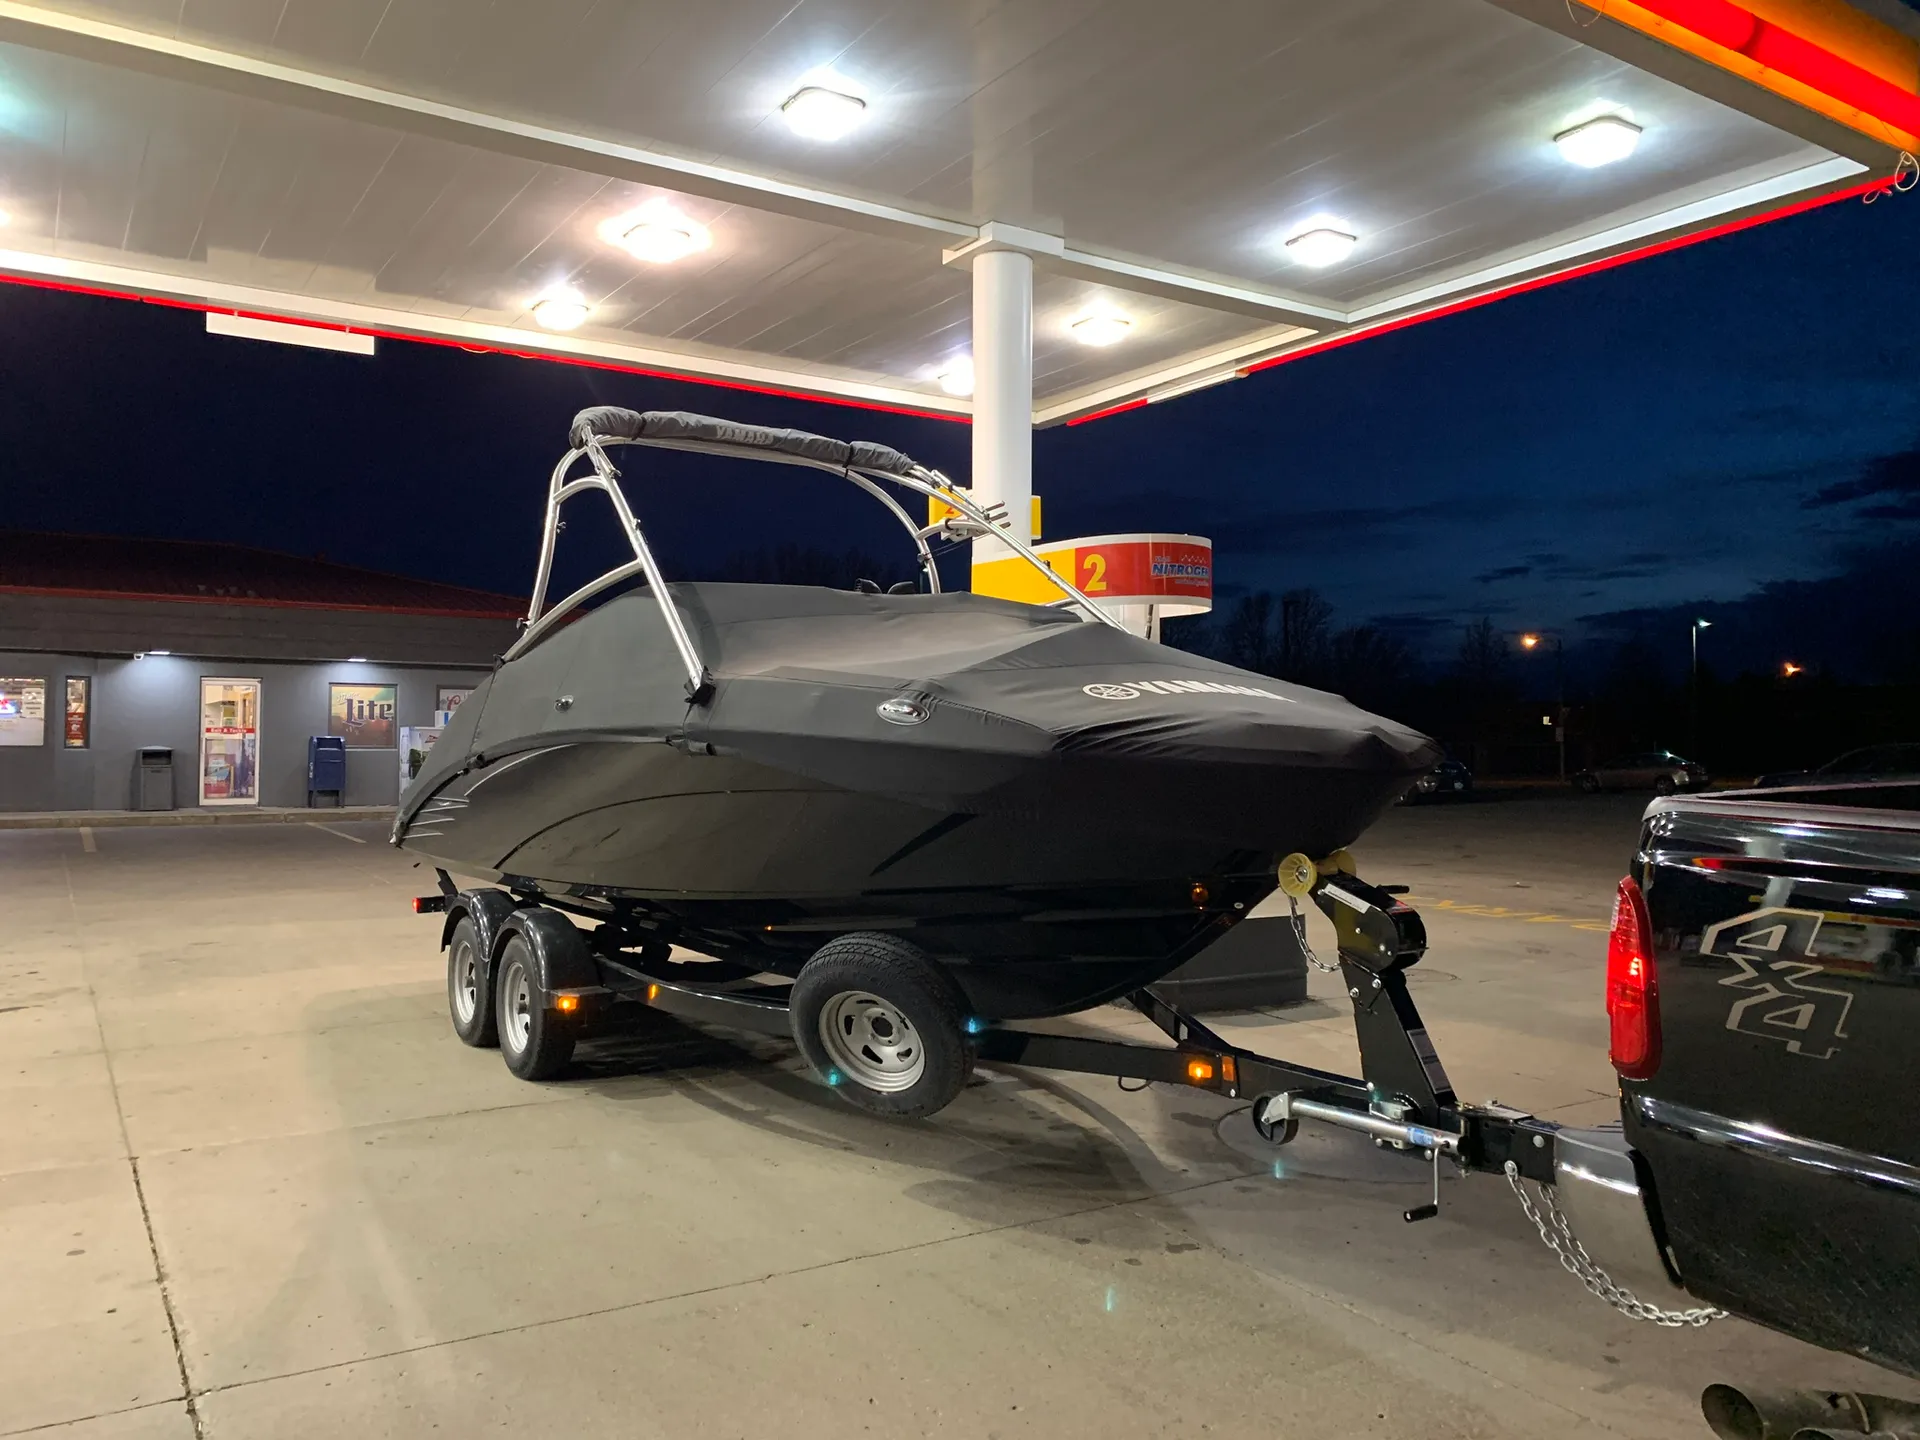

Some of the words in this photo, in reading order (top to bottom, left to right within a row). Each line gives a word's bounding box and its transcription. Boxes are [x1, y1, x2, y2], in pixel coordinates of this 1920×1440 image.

[716, 425, 775, 445] YAMAHA
[1083, 553, 1107, 592] 2
[342, 698, 394, 727] Lite
